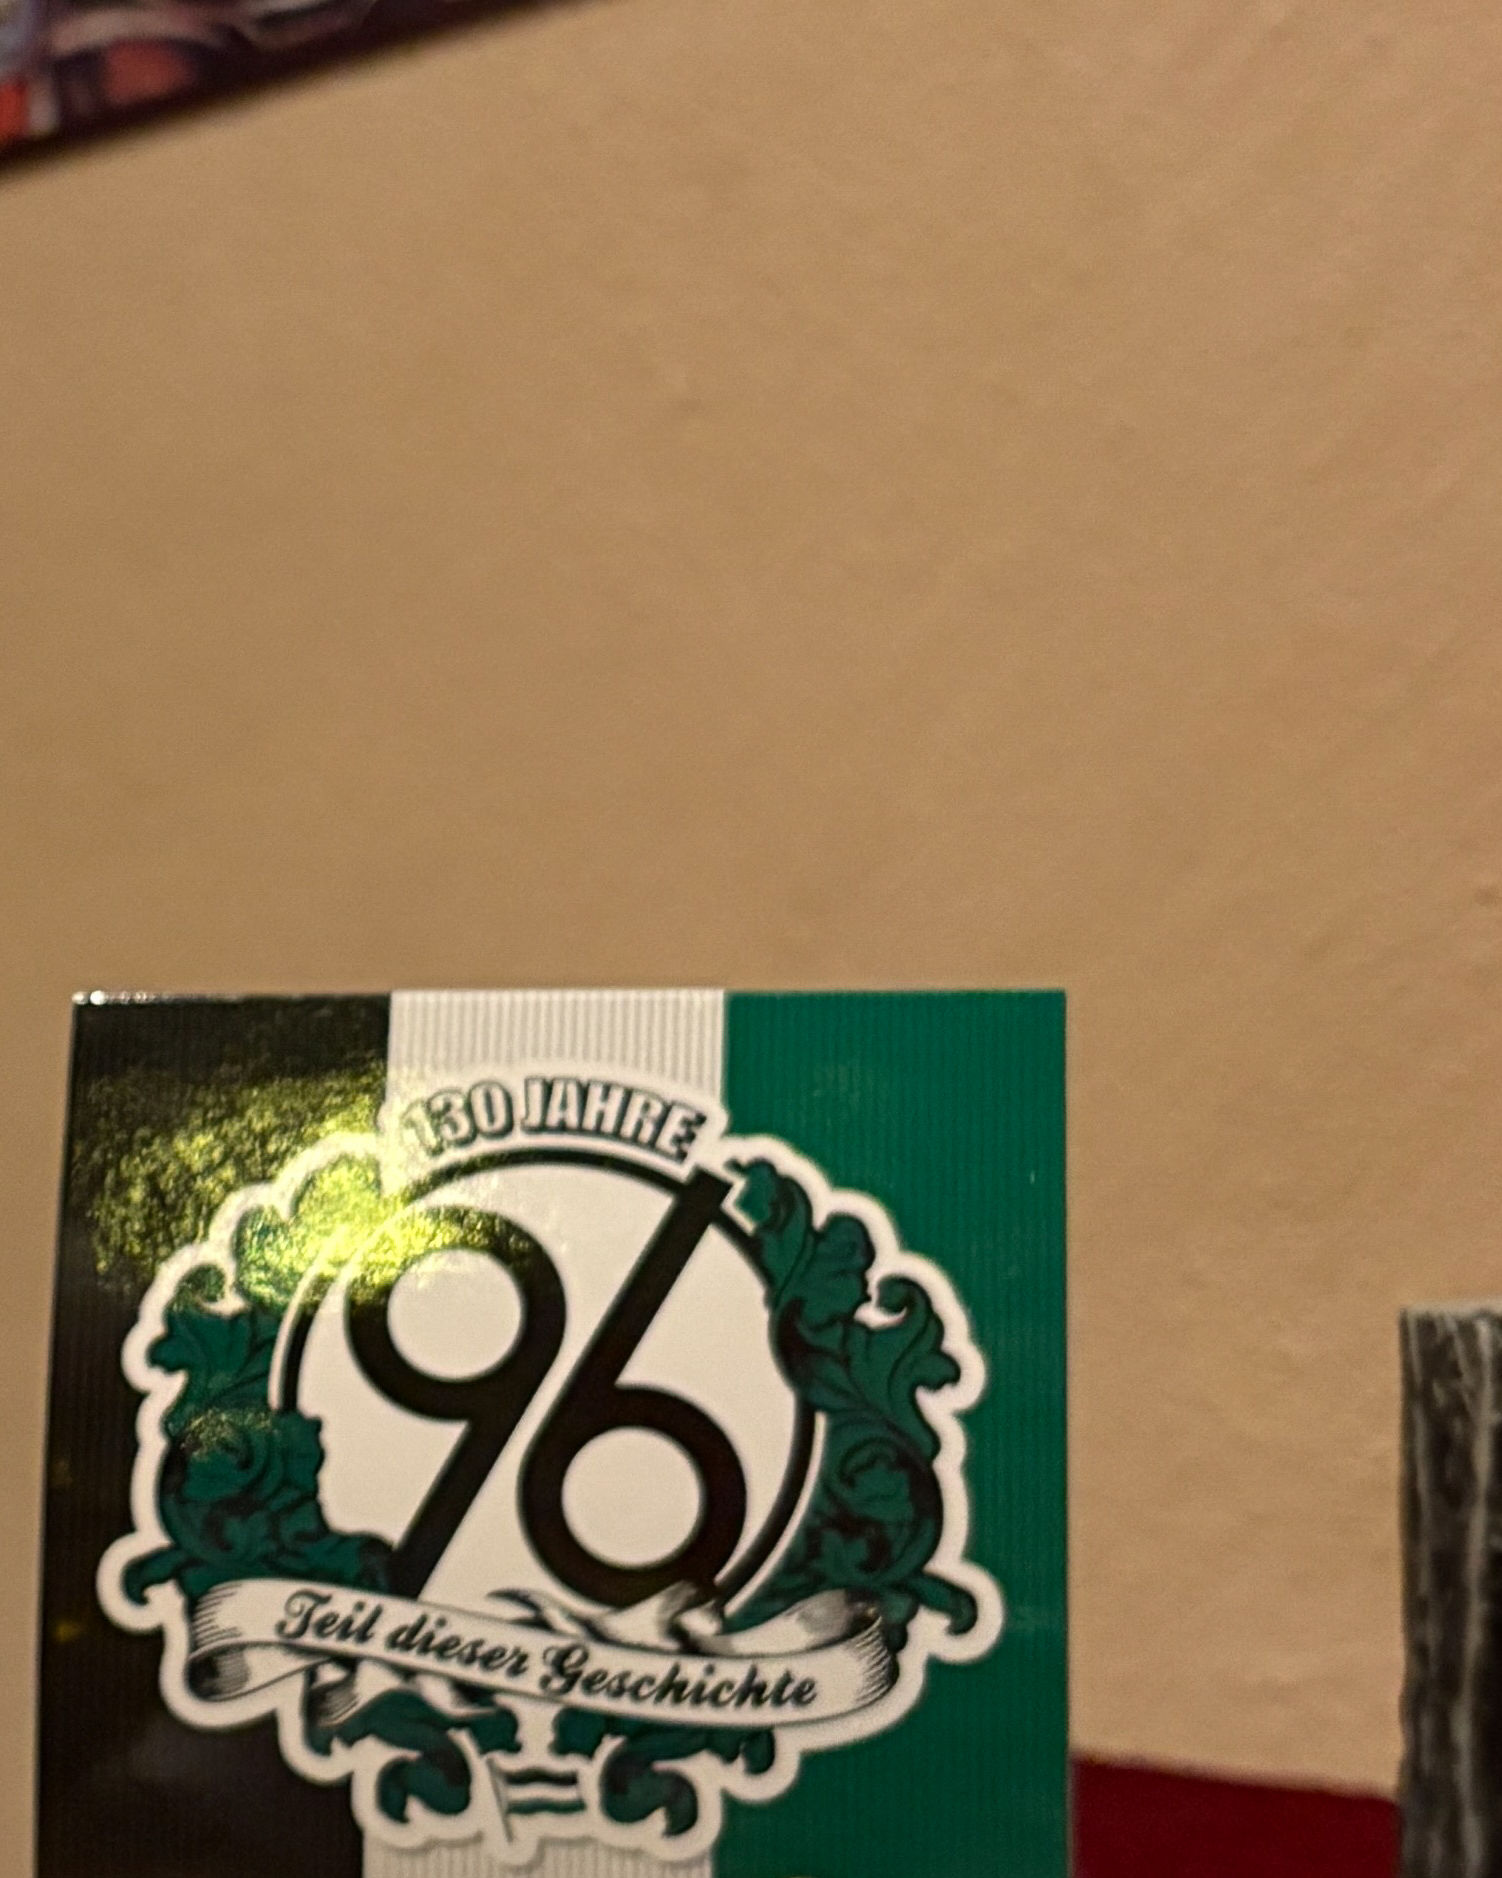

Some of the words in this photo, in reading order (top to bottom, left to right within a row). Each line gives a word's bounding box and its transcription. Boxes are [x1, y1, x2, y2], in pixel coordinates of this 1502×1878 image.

[402, 1080, 513, 1155] 130
[521, 1077, 707, 1162] JAHRE
[343, 1164, 748, 1610] 96
[274, 1591, 380, 1647] Teil
[385, 1610, 530, 1677] dieser
[539, 1645, 819, 1708] Geschichte
